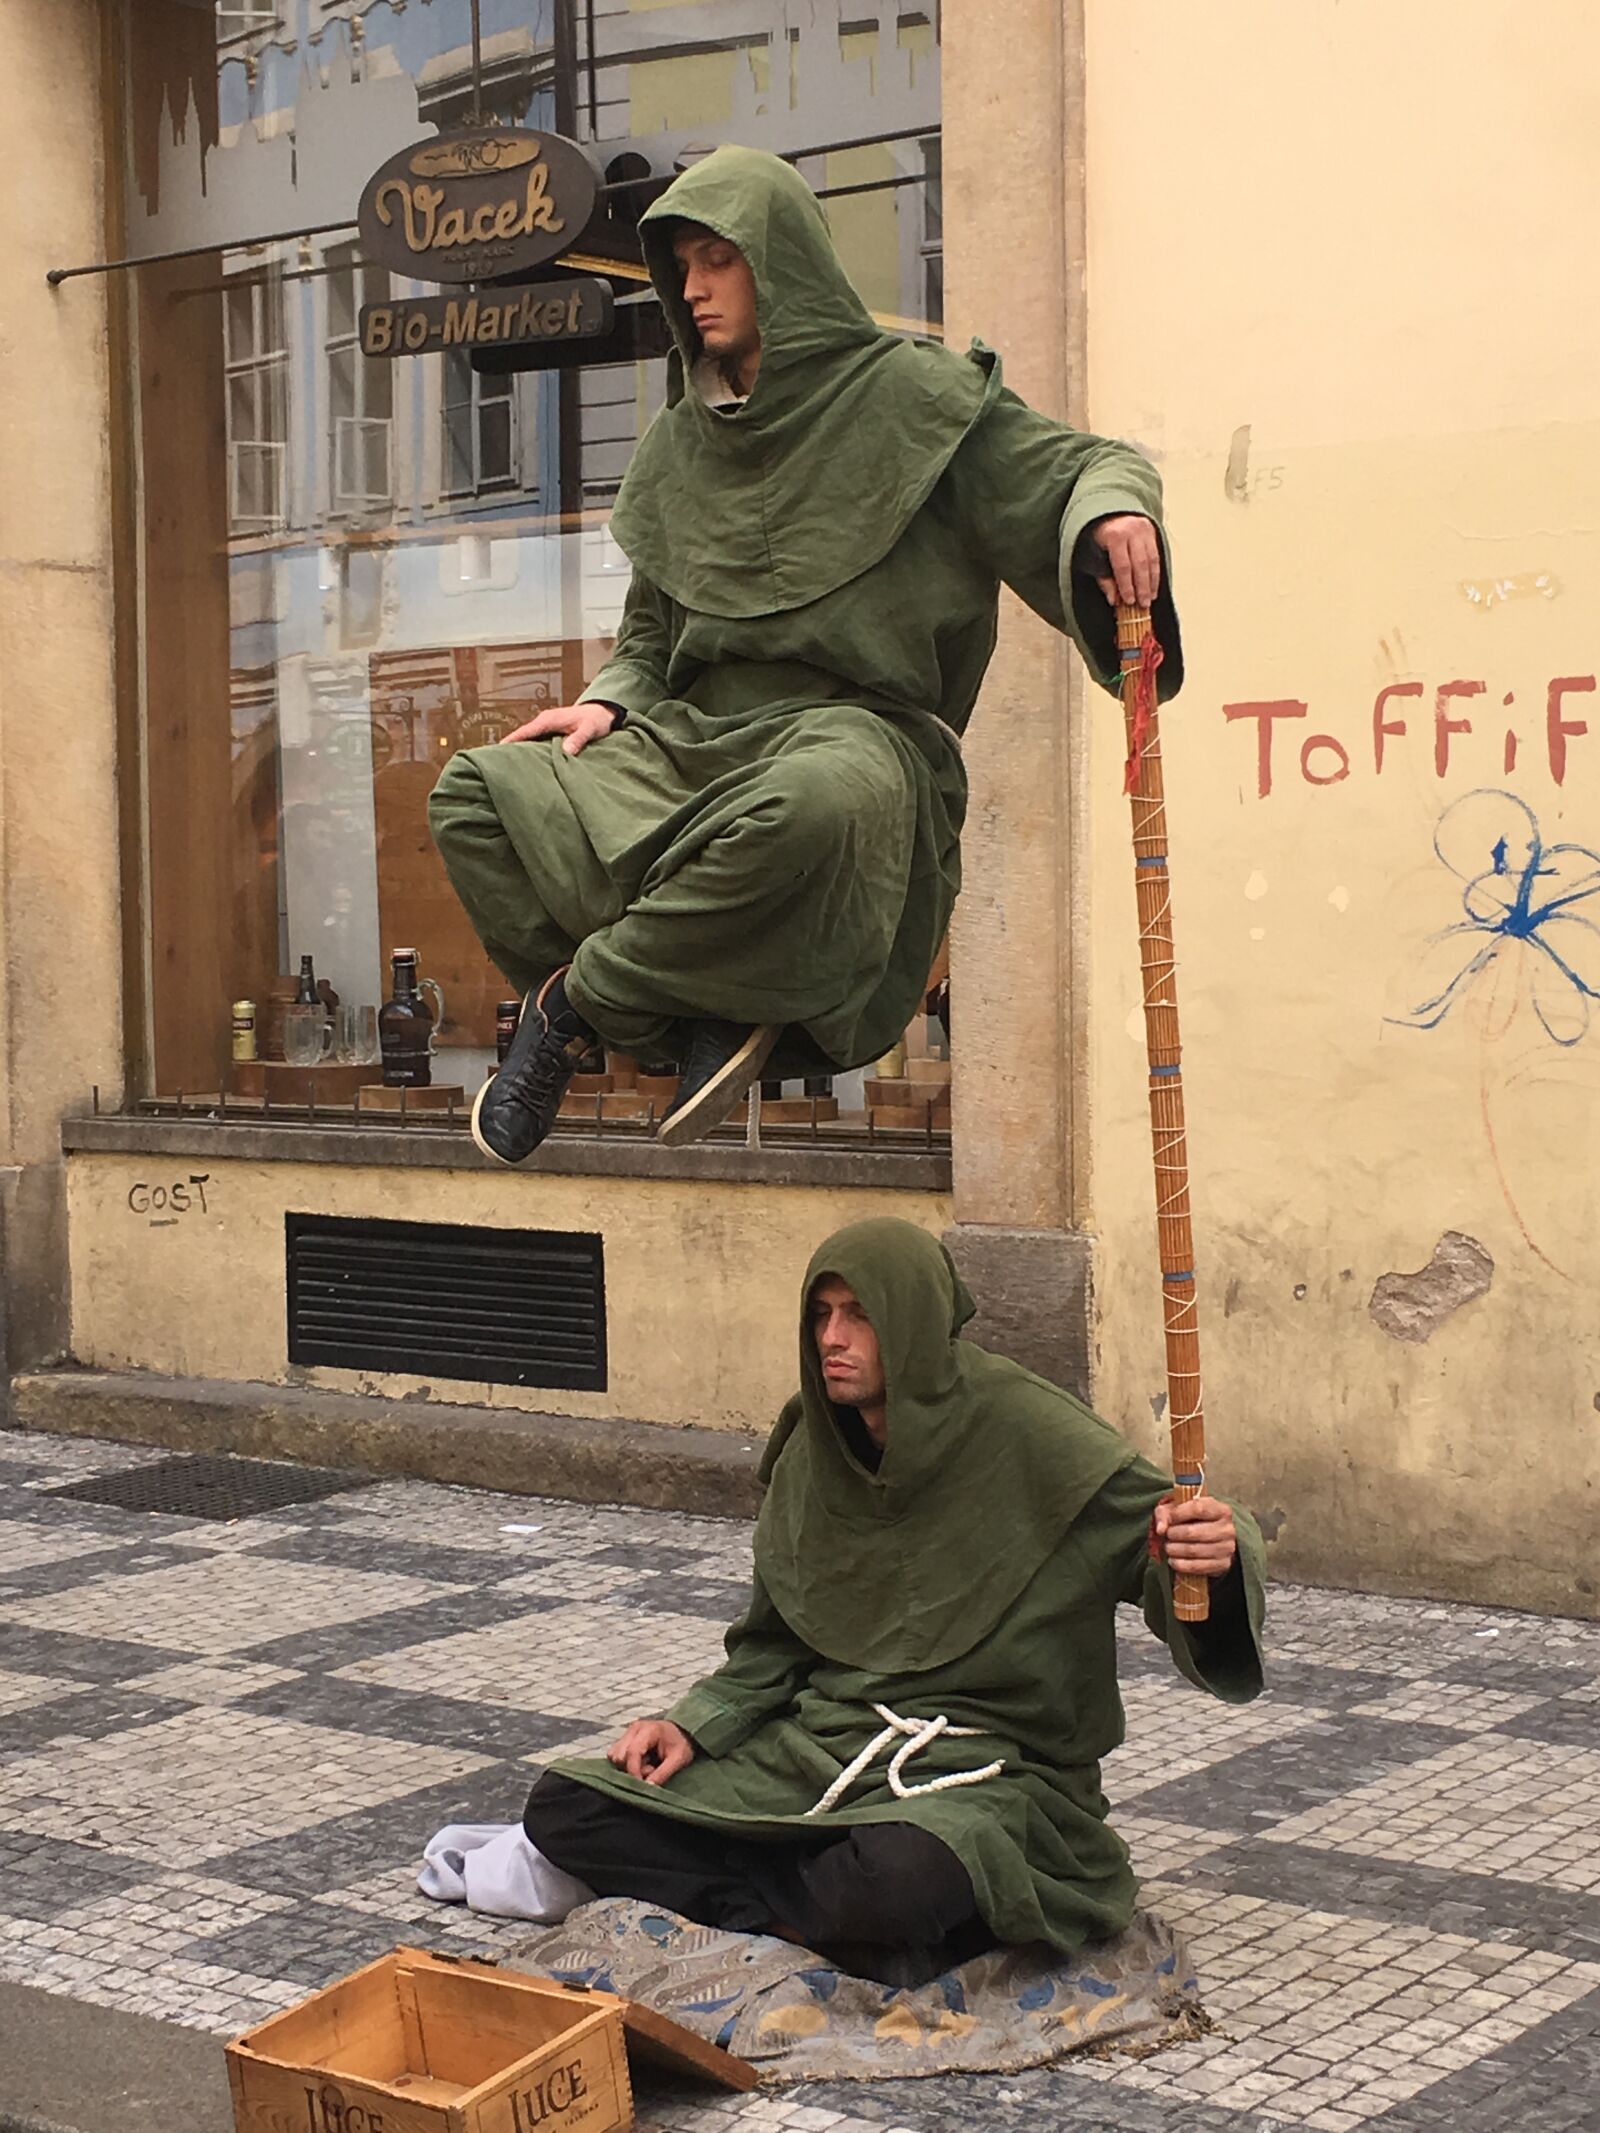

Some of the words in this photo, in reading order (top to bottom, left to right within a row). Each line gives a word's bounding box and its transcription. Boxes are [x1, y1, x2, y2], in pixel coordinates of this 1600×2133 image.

[375, 162, 565, 253] Vacek
[365, 289, 584, 354] Bio-Market
[128, 1174, 210, 1214] GOST
